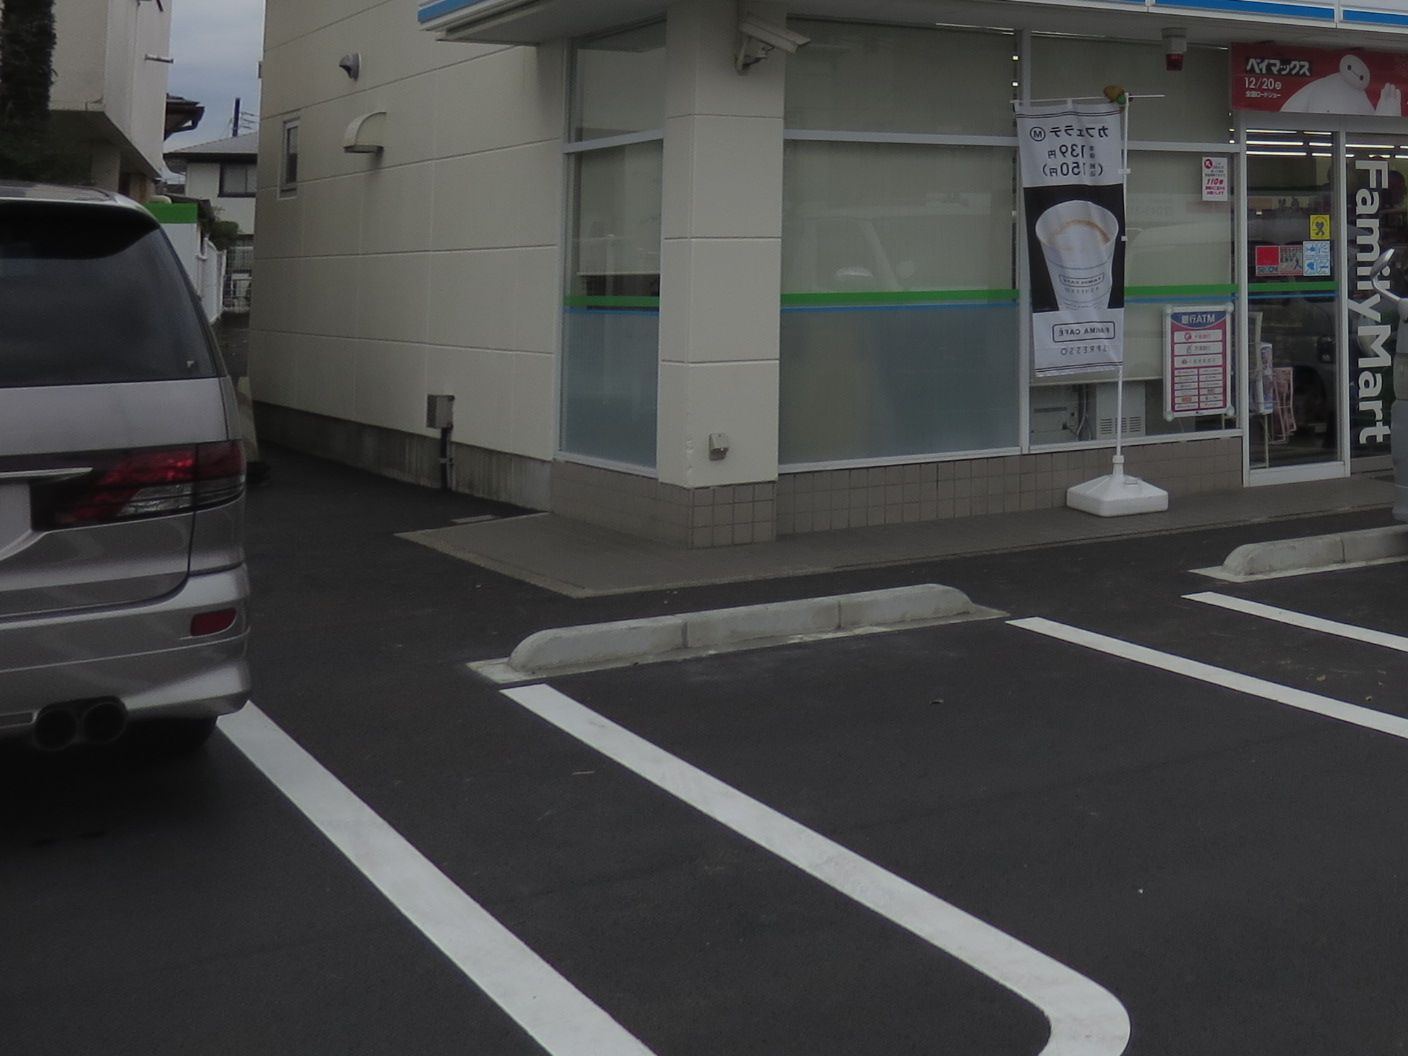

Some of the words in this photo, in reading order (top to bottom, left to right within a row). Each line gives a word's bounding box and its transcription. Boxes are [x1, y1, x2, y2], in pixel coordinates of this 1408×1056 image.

[1246, 58, 1311, 76] ベイマックス
[1348, 160, 1392, 445] FamilyMart
